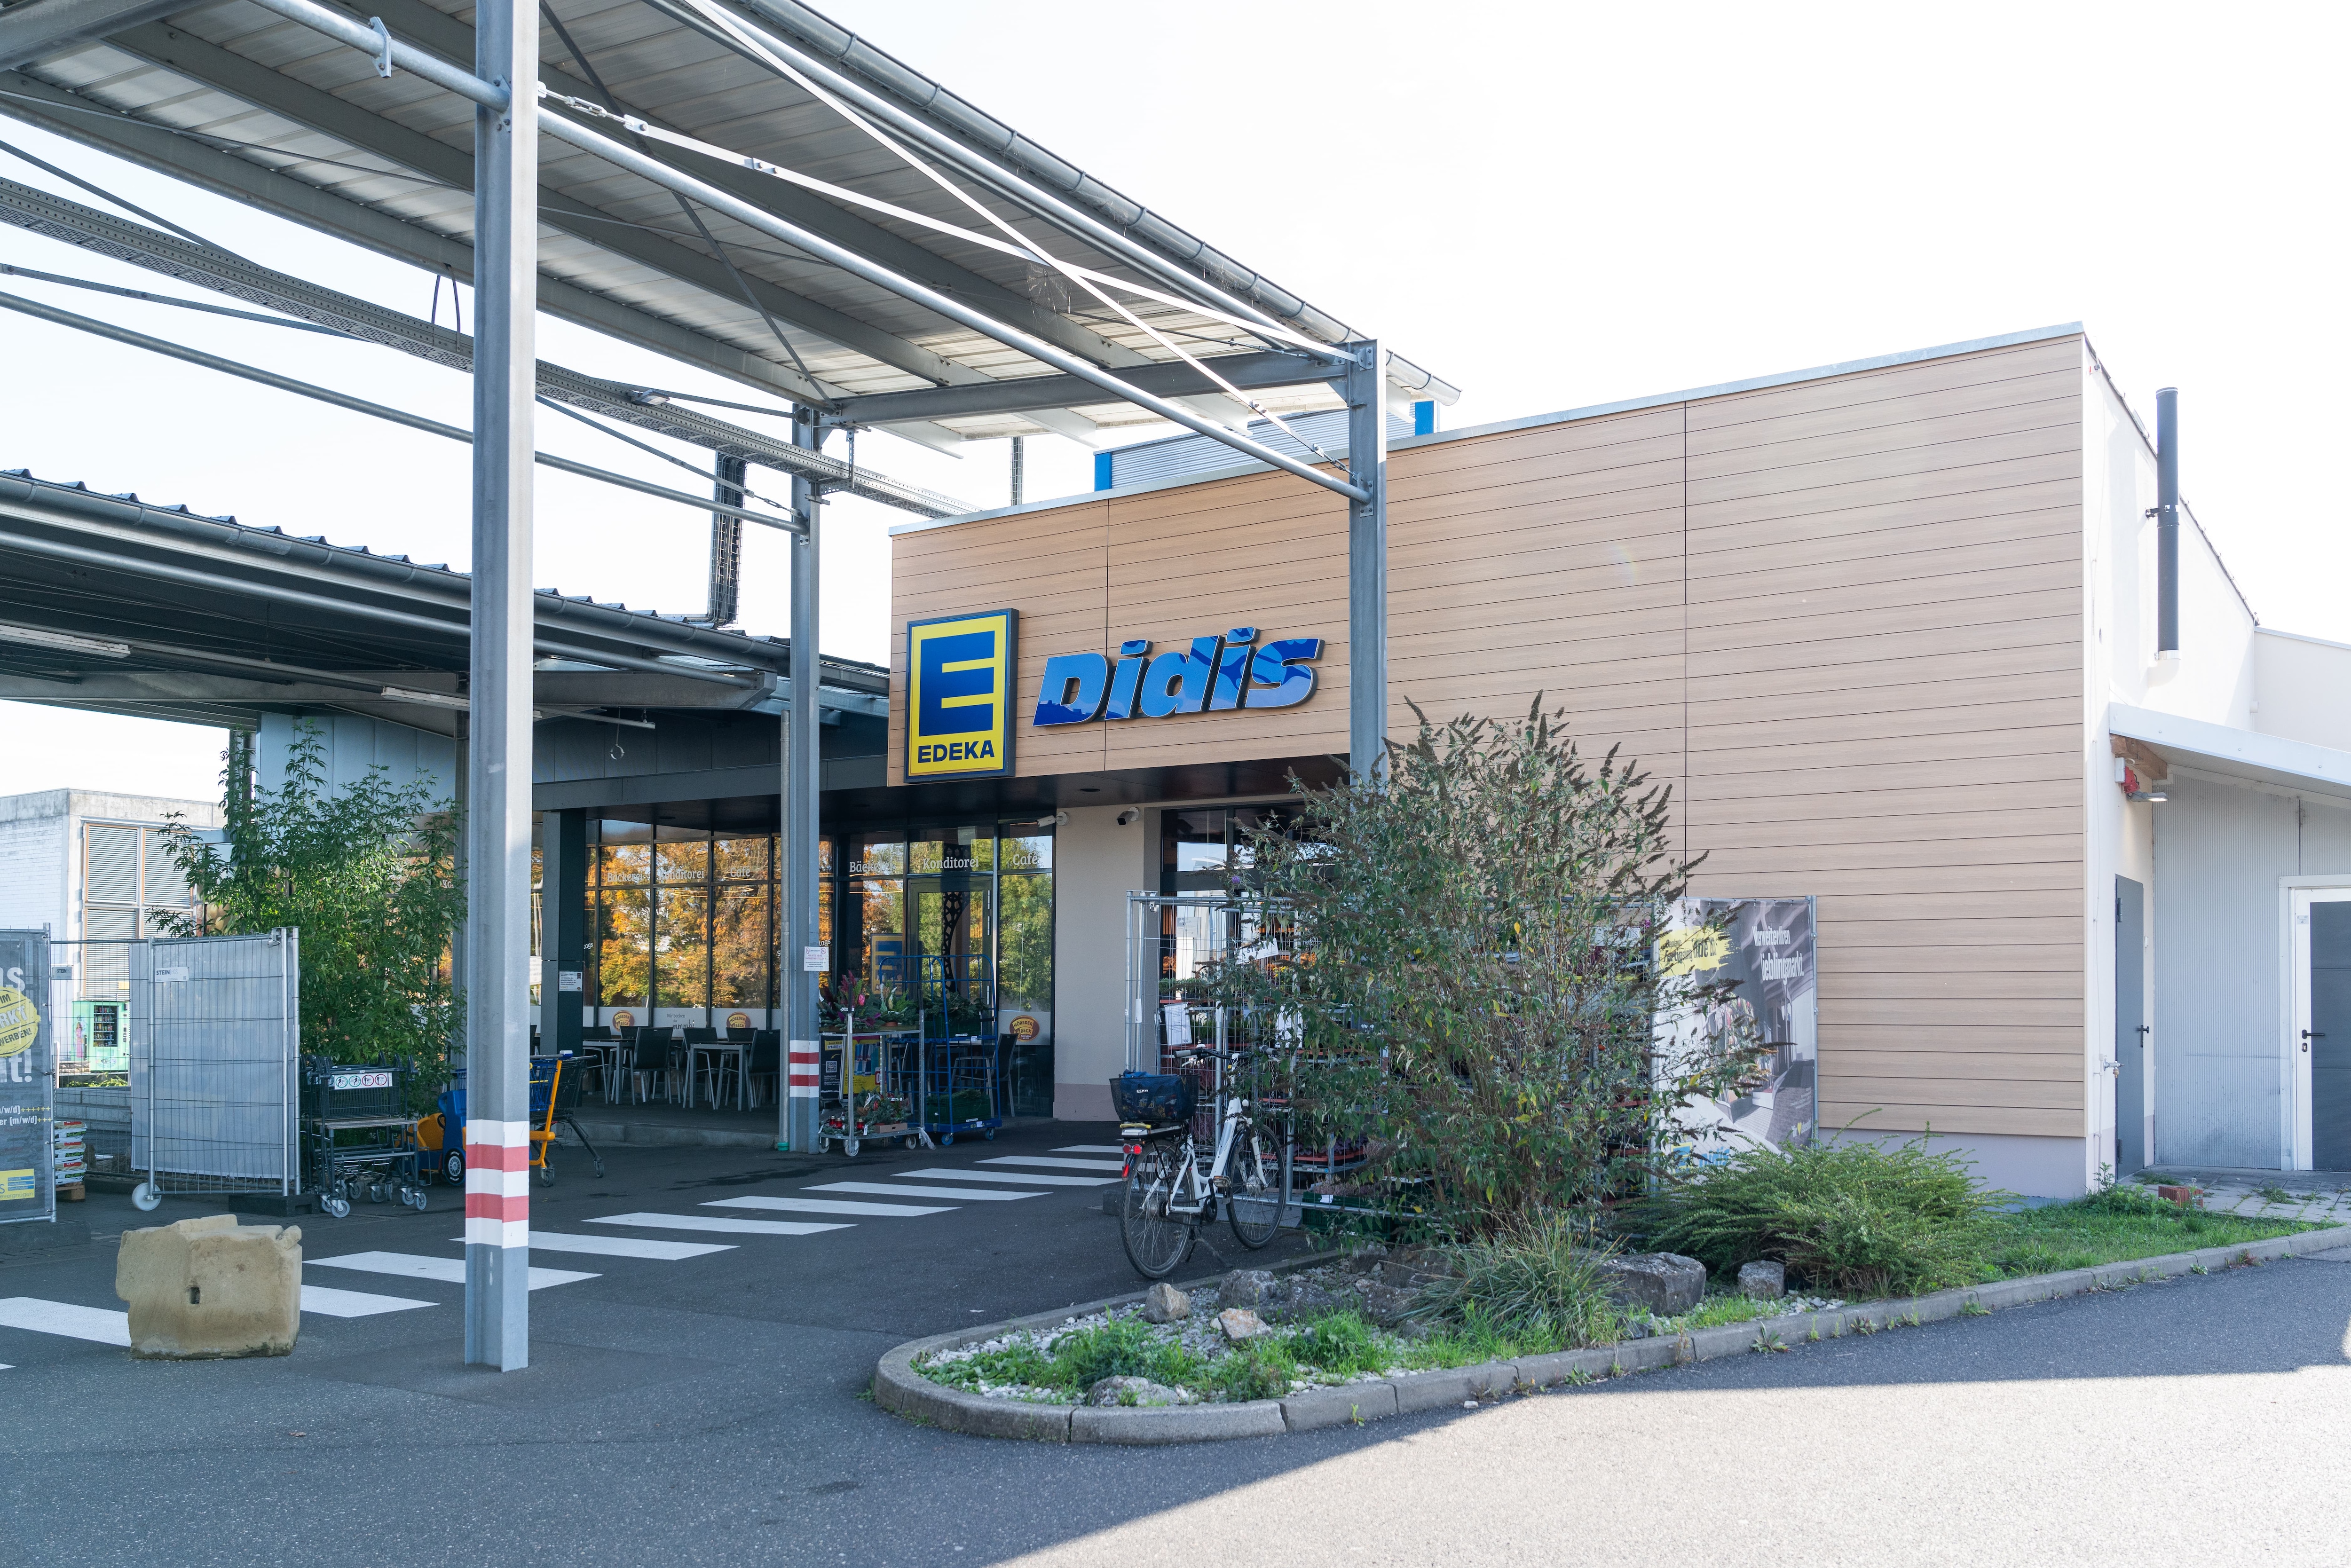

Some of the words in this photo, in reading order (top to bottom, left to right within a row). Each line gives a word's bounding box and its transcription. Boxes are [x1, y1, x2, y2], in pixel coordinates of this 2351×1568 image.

[919, 630, 995, 737] E
[1033, 626, 1325, 727] Didis
[918, 740, 995, 763] EDEKA
[607, 871, 643, 882] Bäckerei
[658, 867, 705, 880] Konditorei
[850, 860, 895, 872] Bäckerei
[923, 855, 979, 869] Konditorei
[0, 1005, 28, 1029] RKT
